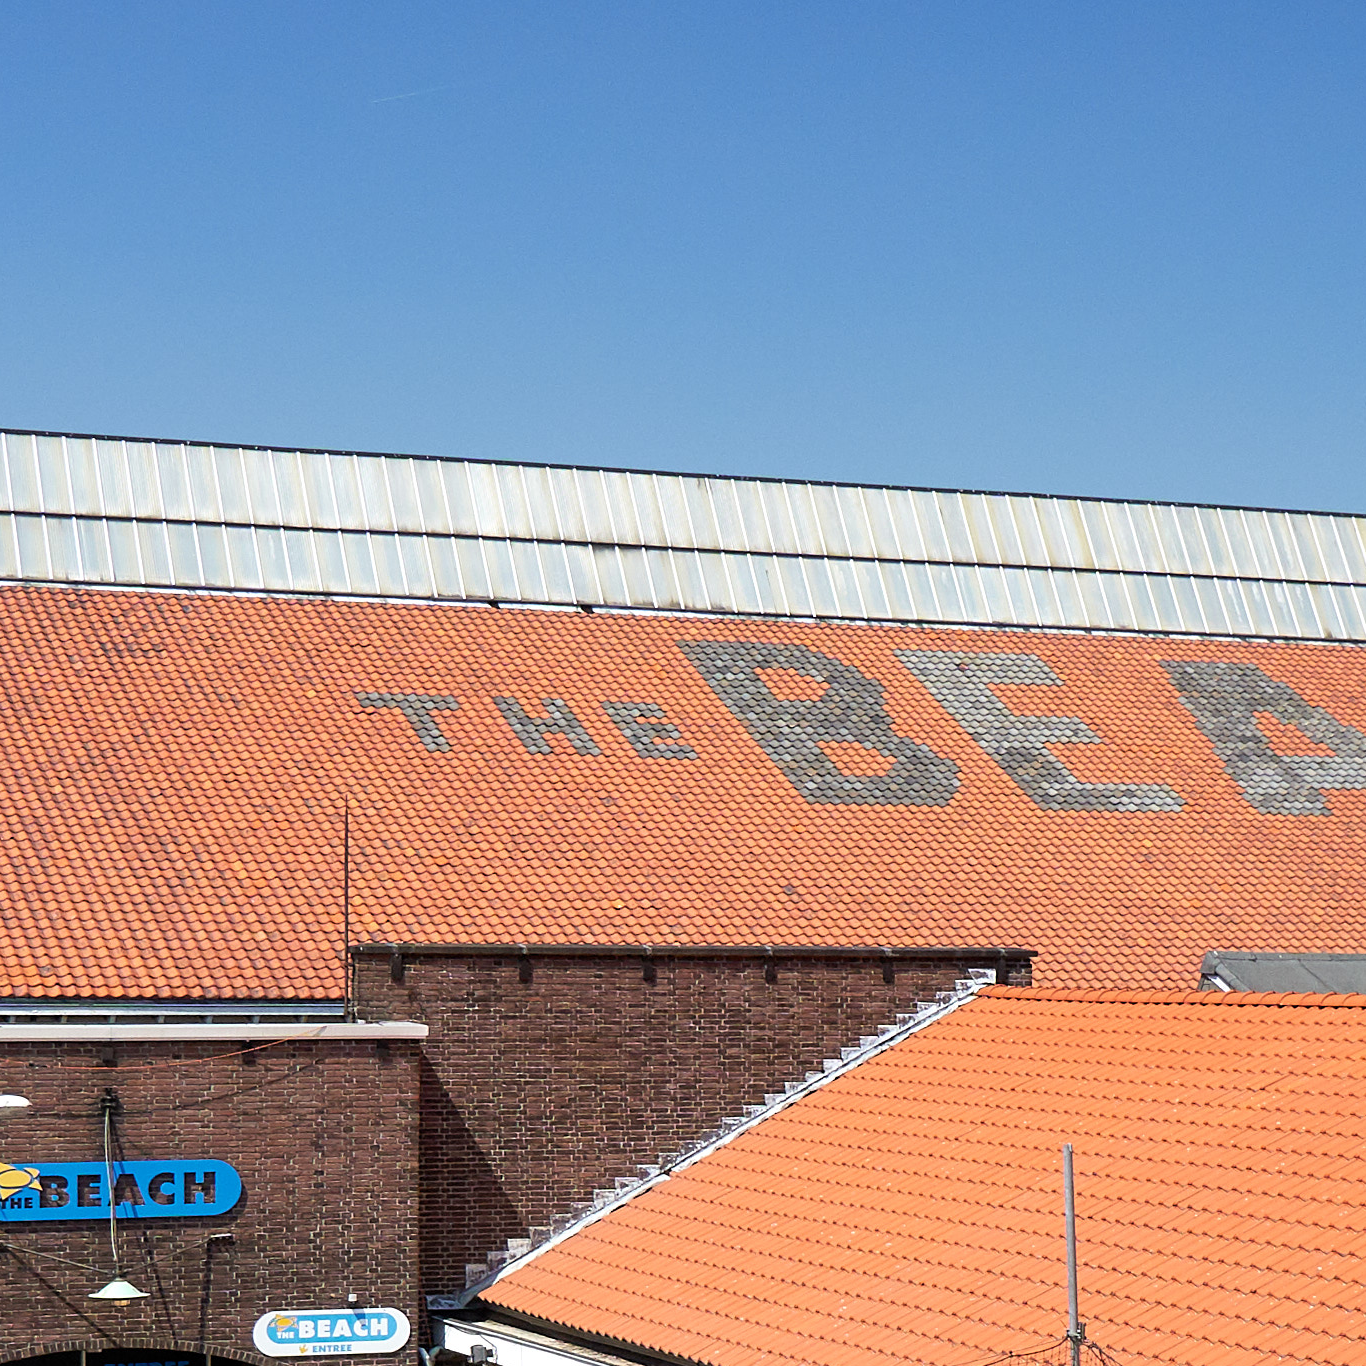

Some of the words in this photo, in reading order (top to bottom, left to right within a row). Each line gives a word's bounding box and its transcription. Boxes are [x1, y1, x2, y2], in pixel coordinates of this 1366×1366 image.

[359, 692, 699, 760] THE
[39, 1171, 216, 1209] BEACH
[276, 1331, 295, 1340] THE
[298, 1318, 389, 1339] BEACH
[312, 1344, 353, 1353] ENTREE
